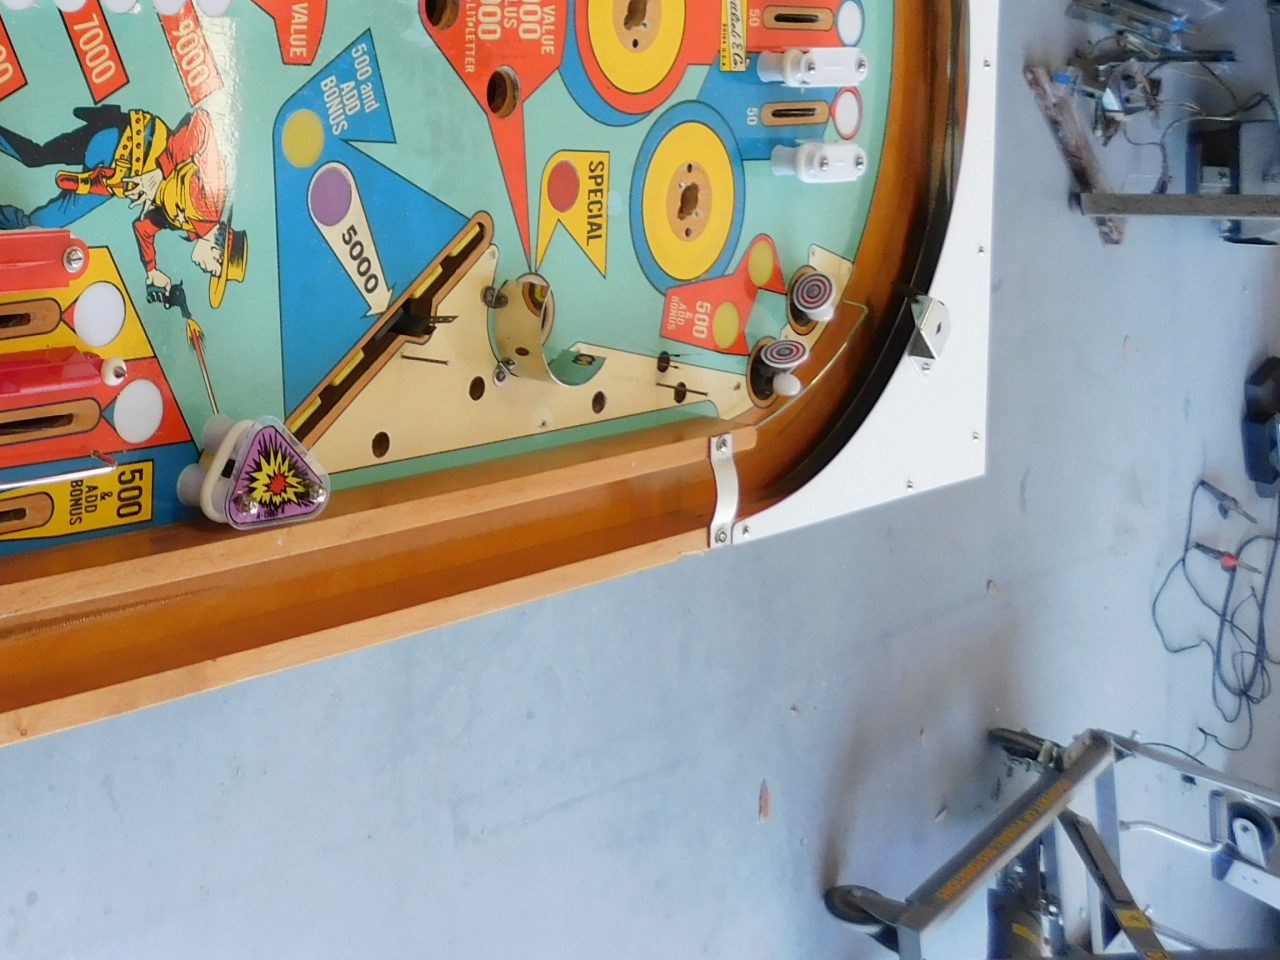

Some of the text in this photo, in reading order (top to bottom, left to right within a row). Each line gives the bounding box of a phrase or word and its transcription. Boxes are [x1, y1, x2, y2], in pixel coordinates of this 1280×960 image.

[290, 3, 309, 58] VALUE
[541, 5, 556, 55] VALUE
[749, 8, 760, 27] 50
[74, 14, 115, 85] 7000
[172, 22, 210, 91] 9000
[464, 26, 476, 73] LETTER
[340, 80, 361, 115] ADD
[351, 43, 380, 113] 500 and
[320, 75, 348, 136] BONUS
[747, 107, 758, 126] 50
[586, 160, 604, 247] SPECIAL
[342, 227, 378, 295] 5000
[667, 295, 680, 330] BONUS
[676, 302, 688, 326] ADD
[692, 300, 711, 338] 500
[69, 479, 83, 526] BONUS
[85, 485, 99, 513] ADD
[100, 491, 113, 501] &
[117, 468, 144, 518] 500
